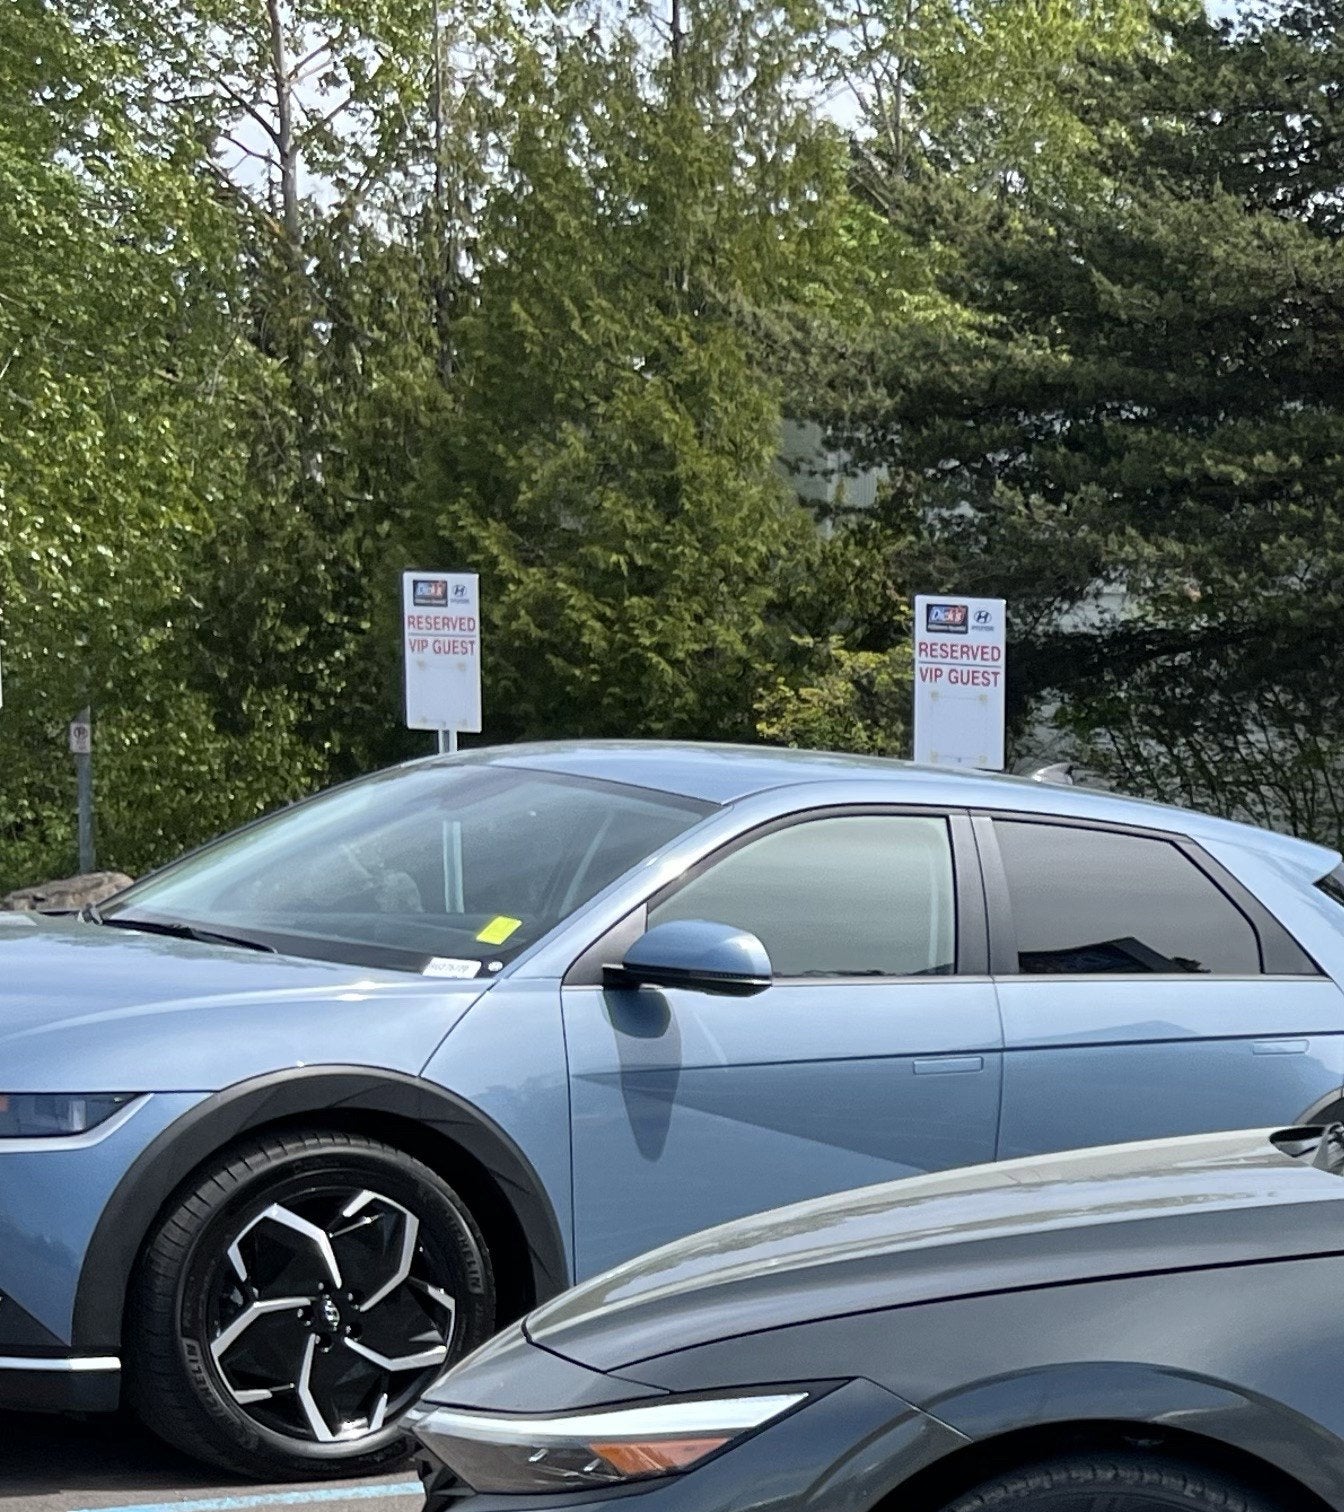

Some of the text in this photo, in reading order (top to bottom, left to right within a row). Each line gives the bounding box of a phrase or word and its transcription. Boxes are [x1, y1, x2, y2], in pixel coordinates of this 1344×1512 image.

[407, 614, 476, 633] RESERVED
[408, 639, 476, 656] VIP GUEST
[918, 641, 1001, 662] RESERVED
[919, 666, 1001, 687] VIP GUEST
